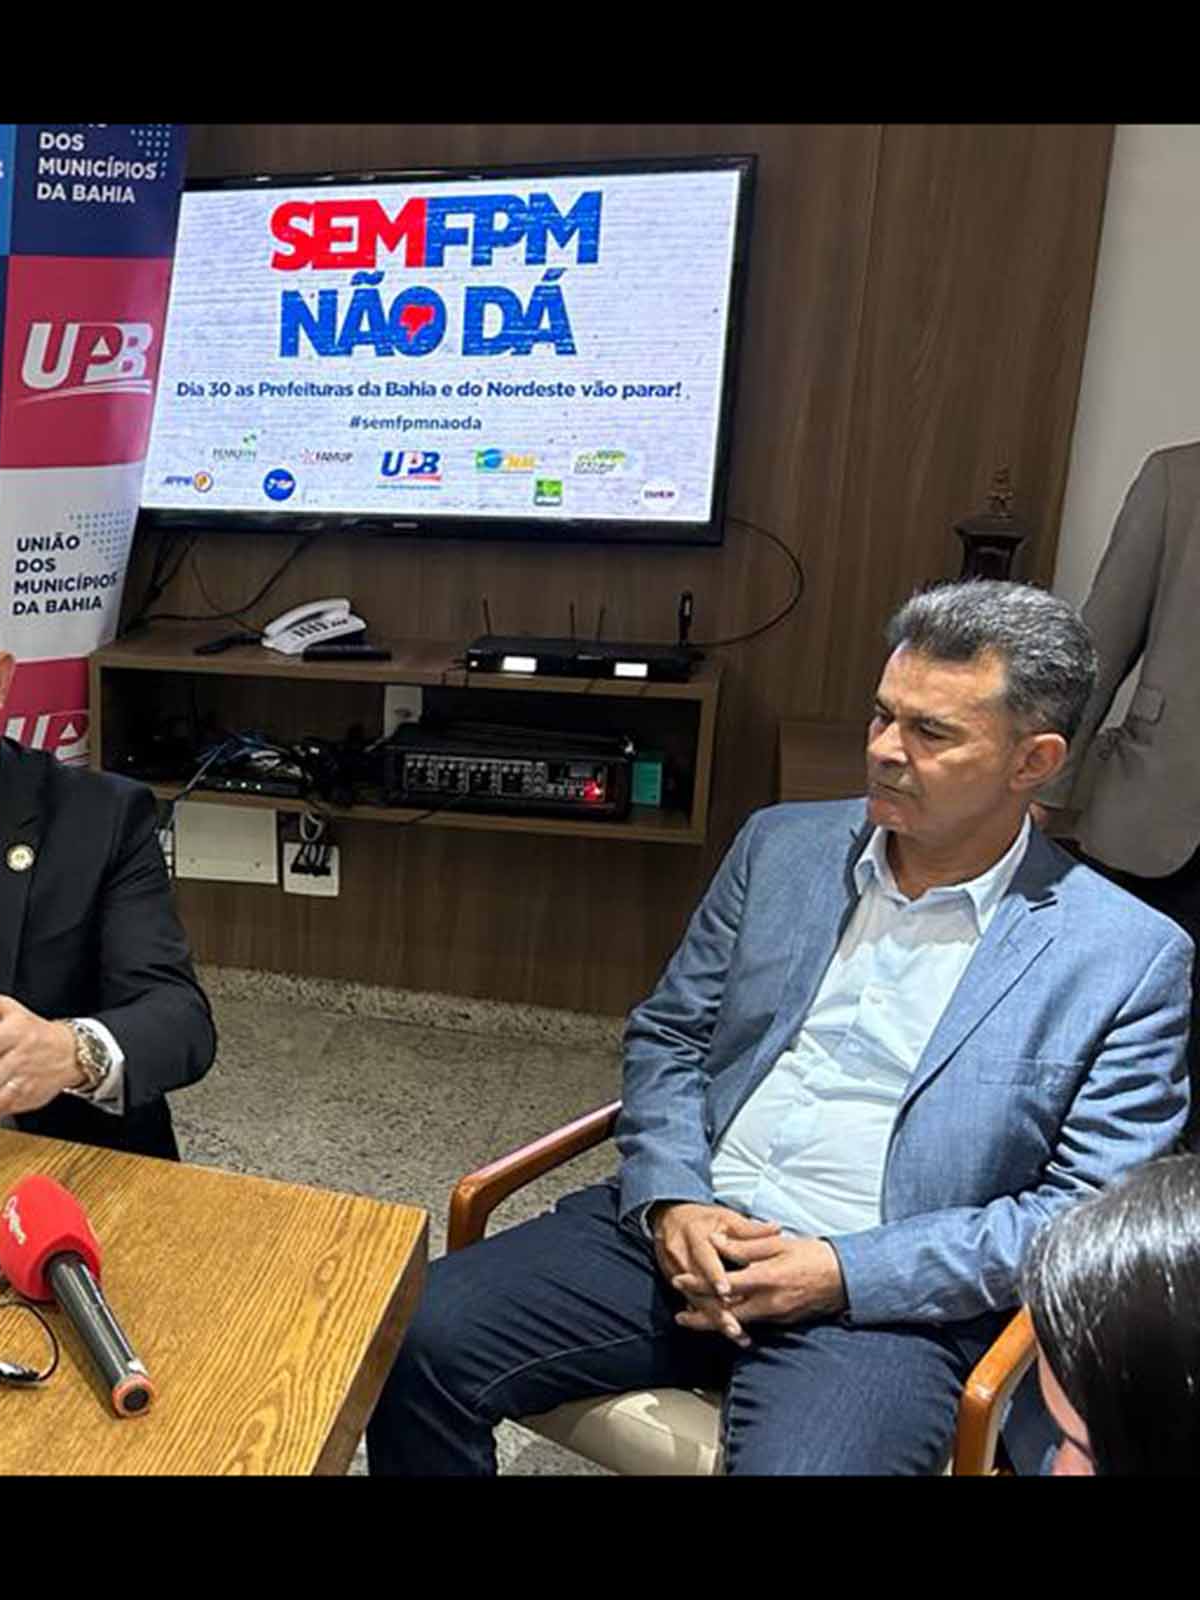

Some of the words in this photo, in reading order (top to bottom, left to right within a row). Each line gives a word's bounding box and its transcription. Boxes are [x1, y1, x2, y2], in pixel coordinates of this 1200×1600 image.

[39, 132, 85, 151] DOS
[38, 155, 157, 181] MUNICÍPIOS
[36, 183, 68, 201] DA
[71, 184, 136, 204] BAHIA
[279, 270, 448, 358] NÃO
[462, 267, 578, 357] DÁ
[21, 321, 155, 391] UPB
[176, 381, 205, 397] Dia
[208, 382, 231, 397] 30
[234, 384, 254, 397] as
[258, 381, 353, 398] Prefeituras
[358, 381, 381, 397] da
[385, 381, 437, 397] Bahia
[441, 384, 453, 397] e
[456, 381, 482, 397] do
[486, 381, 576, 398] Nordeste
[580, 379, 617, 397] vão
[621, 381, 682, 400] parar!
[350, 415, 483, 432] #semfpmnaoda
[381, 450, 441, 477] UPB
[16, 533, 81, 553] UNIÃO
[15, 558, 57, 575] DOS
[14, 571, 118, 595] MUNICÍPIOS
[12, 600, 40, 616] DA
[45, 595, 103, 614] BAHIA
